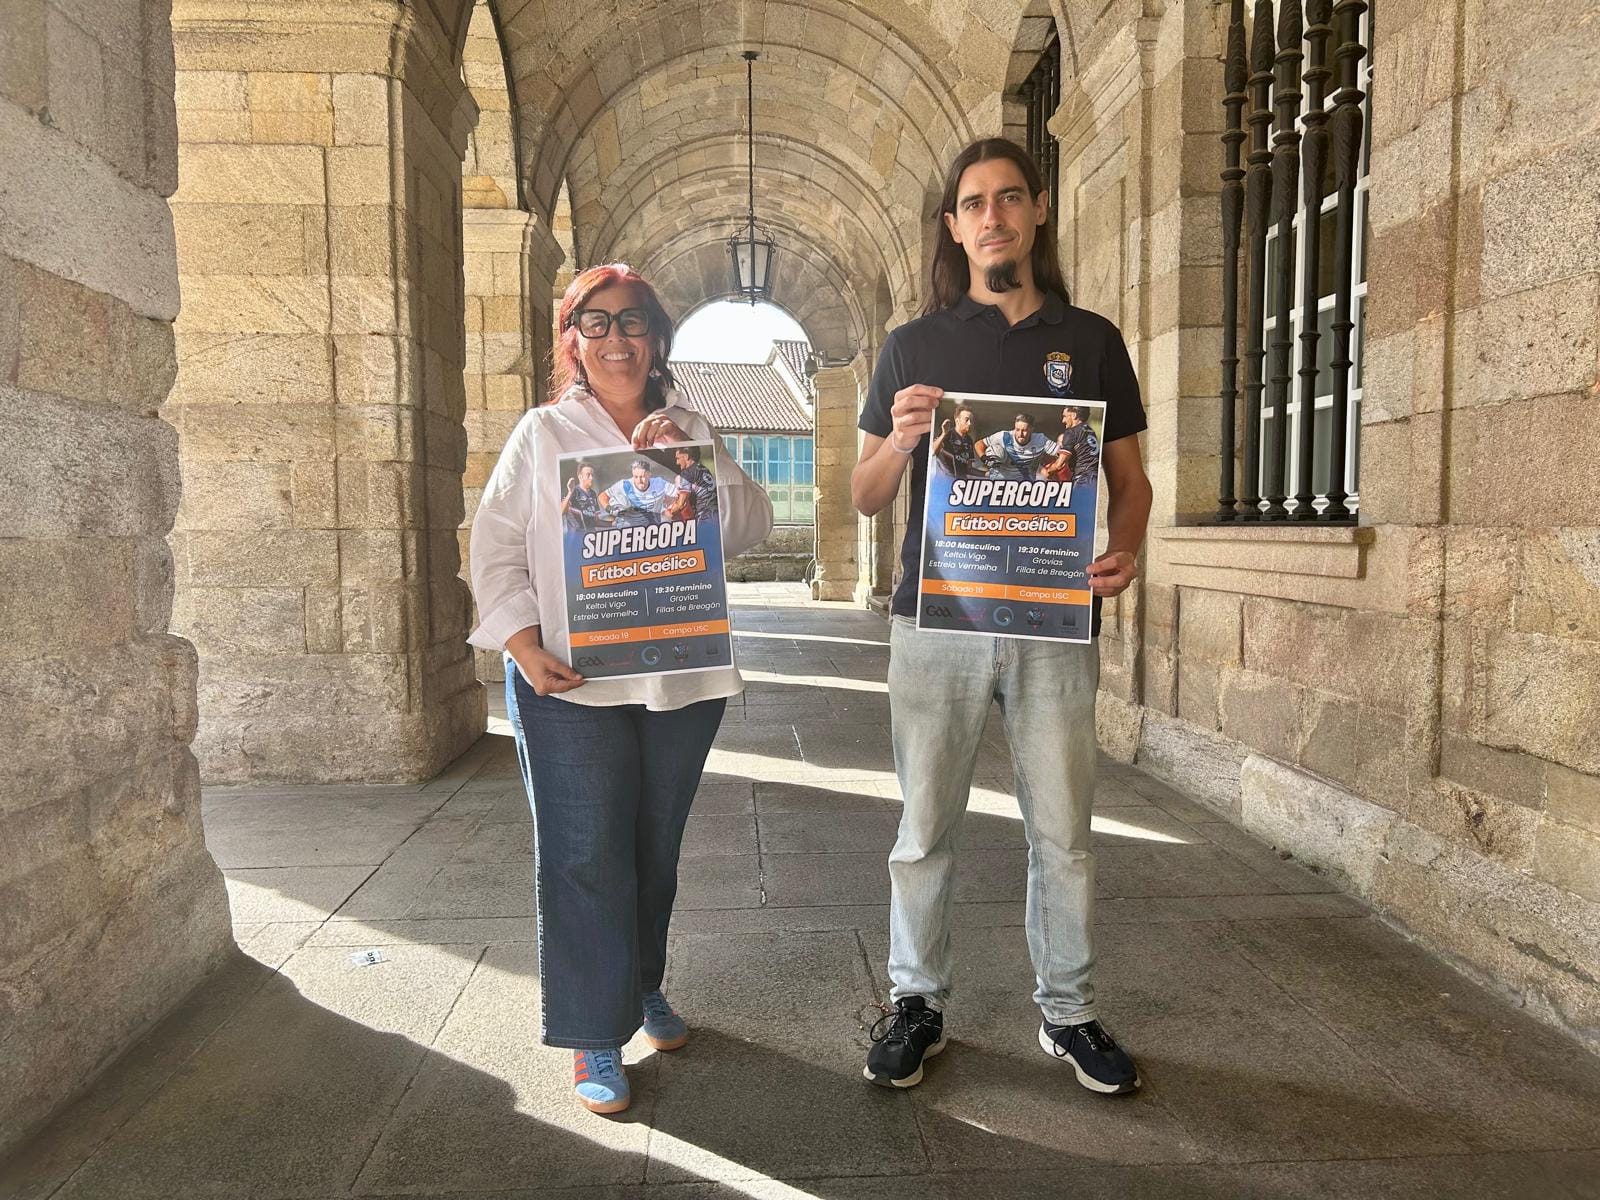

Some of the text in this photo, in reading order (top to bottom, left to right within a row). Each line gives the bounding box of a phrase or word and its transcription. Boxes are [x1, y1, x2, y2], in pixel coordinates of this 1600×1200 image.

[950, 479, 1073, 508] SUPERCOPA
[951, 514, 1068, 533] Fútbol Gaélico
[582, 519, 697, 560] SUPERCOPA
[934, 540, 1000, 552] 18:00 Masculino
[943, 550, 986, 562] Keltoi Vigo
[1018, 545, 1079, 558] 19:30 Feminino
[588, 555, 698, 584] Fútbol Gaélico
[928, 559, 998, 572] Estrela Vermelha
[1015, 565, 1085, 579] Fillas de Breogán
[575, 588, 639, 602] 18:00 Masculino
[655, 582, 713, 595] 19:30 Feminino
[941, 583, 984, 594] Sábado 19
[1019, 589, 1070, 600] Campo USC
[585, 599, 627, 611] Keltoi Vigo
[655, 605, 675, 614] Fillas
[676, 604, 687, 613] de
[573, 609, 639, 622] Estrela Vermelha
[588, 631, 629, 642] Sábado 19
[663, 624, 710, 637] Campo USC
